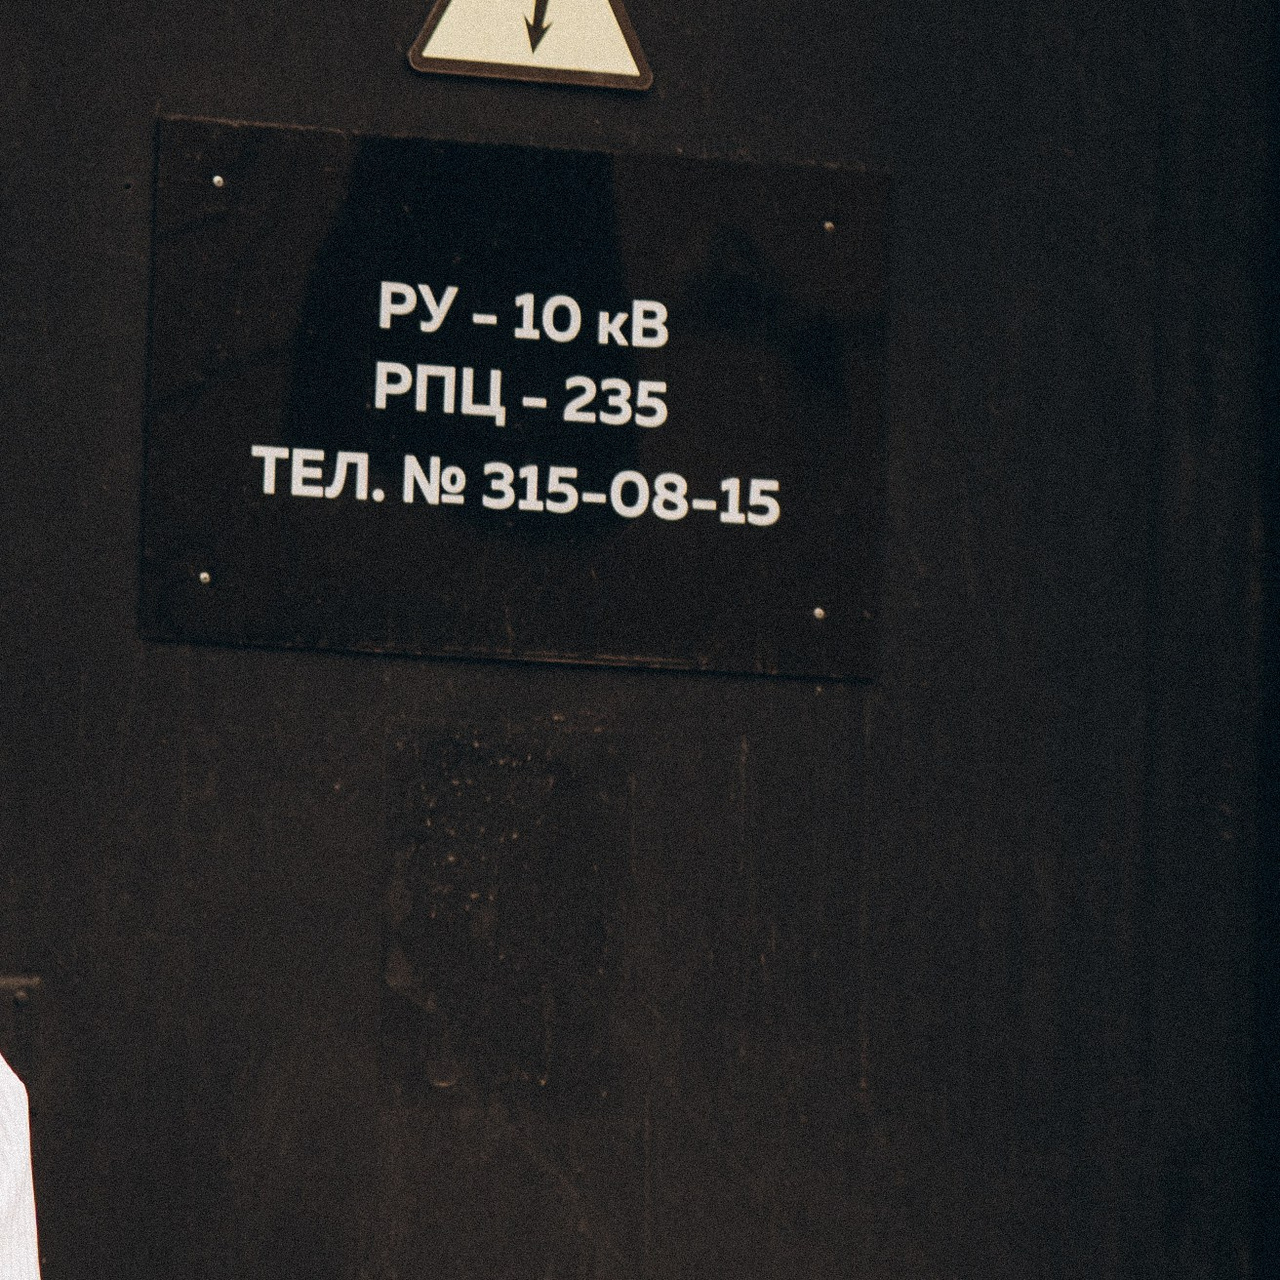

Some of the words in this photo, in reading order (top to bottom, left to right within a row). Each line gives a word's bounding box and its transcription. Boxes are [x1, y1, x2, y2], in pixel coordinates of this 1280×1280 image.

[379, 280, 459, 333] РУ
[514, 292, 582, 343] 10
[598, 299, 669, 348] кВ
[374, 361, 506, 427] РПЦ
[563, 375, 668, 428] 235
[251, 445, 385, 502] ТЕЛ.
[402, 454, 466, 506] №
[482, 461, 781, 526] 315-08-15
